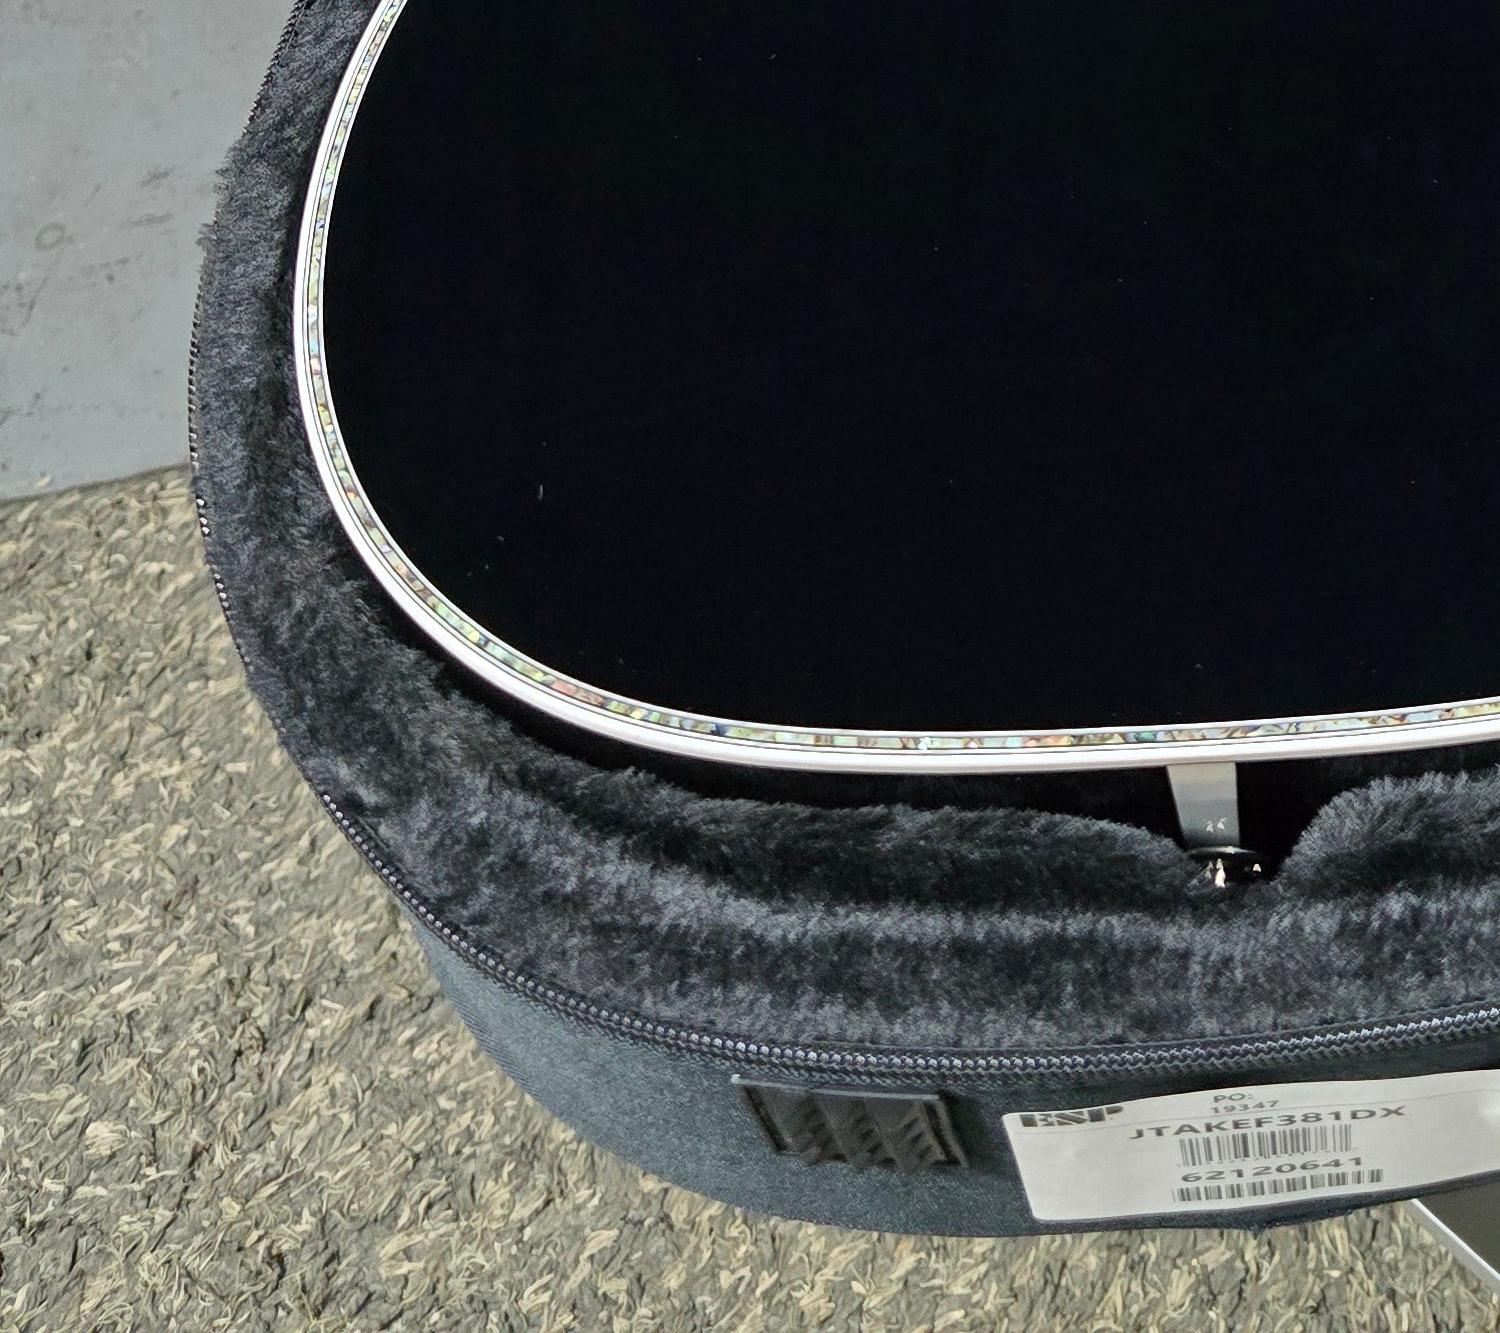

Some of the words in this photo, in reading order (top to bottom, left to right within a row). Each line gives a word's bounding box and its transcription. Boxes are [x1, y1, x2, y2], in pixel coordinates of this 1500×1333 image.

[1211, 1100, 1280, 1114] 19347
[1213, 1092, 1254, 1104] PO:
[1019, 1105, 1124, 1128] ESP
[1128, 1105, 1407, 1140] JTAKEF381DX
[1181, 1156, 1363, 1183] 62120641
